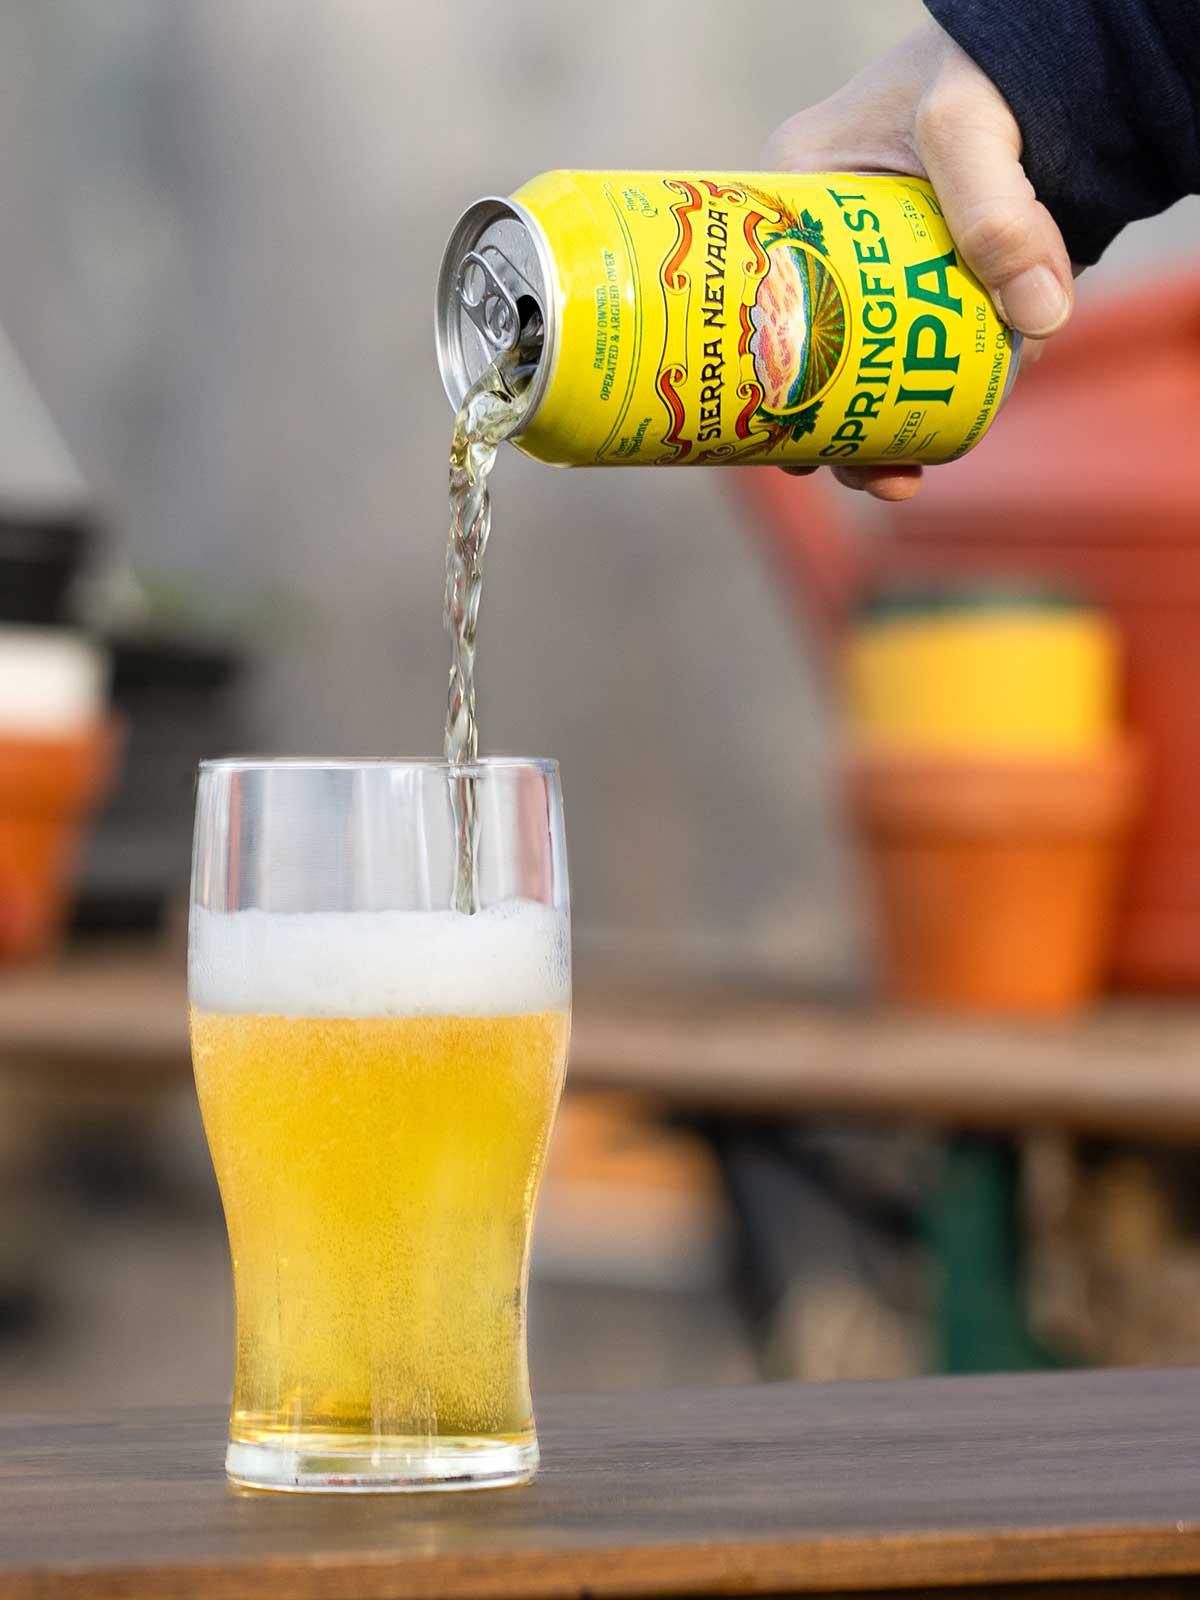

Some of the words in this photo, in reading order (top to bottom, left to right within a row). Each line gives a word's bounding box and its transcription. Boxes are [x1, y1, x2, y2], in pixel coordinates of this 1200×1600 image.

[609, 286, 620, 333] ARGUED
[819, 188, 897, 458] SPRINGFEST
[894, 248, 964, 407] IPA
[976, 302, 987, 322] OZ.
[976, 323, 987, 338] FL.
[594, 330, 607, 370] FAMILY
[976, 342, 985, 353] 12
[600, 344, 619, 401] OPERATED
[697, 338, 725, 442] SIERRA
[966, 408, 991, 445] NEVADA
[983, 352, 1005, 406] BREWING
[892, 411, 922, 455] LIMITED
